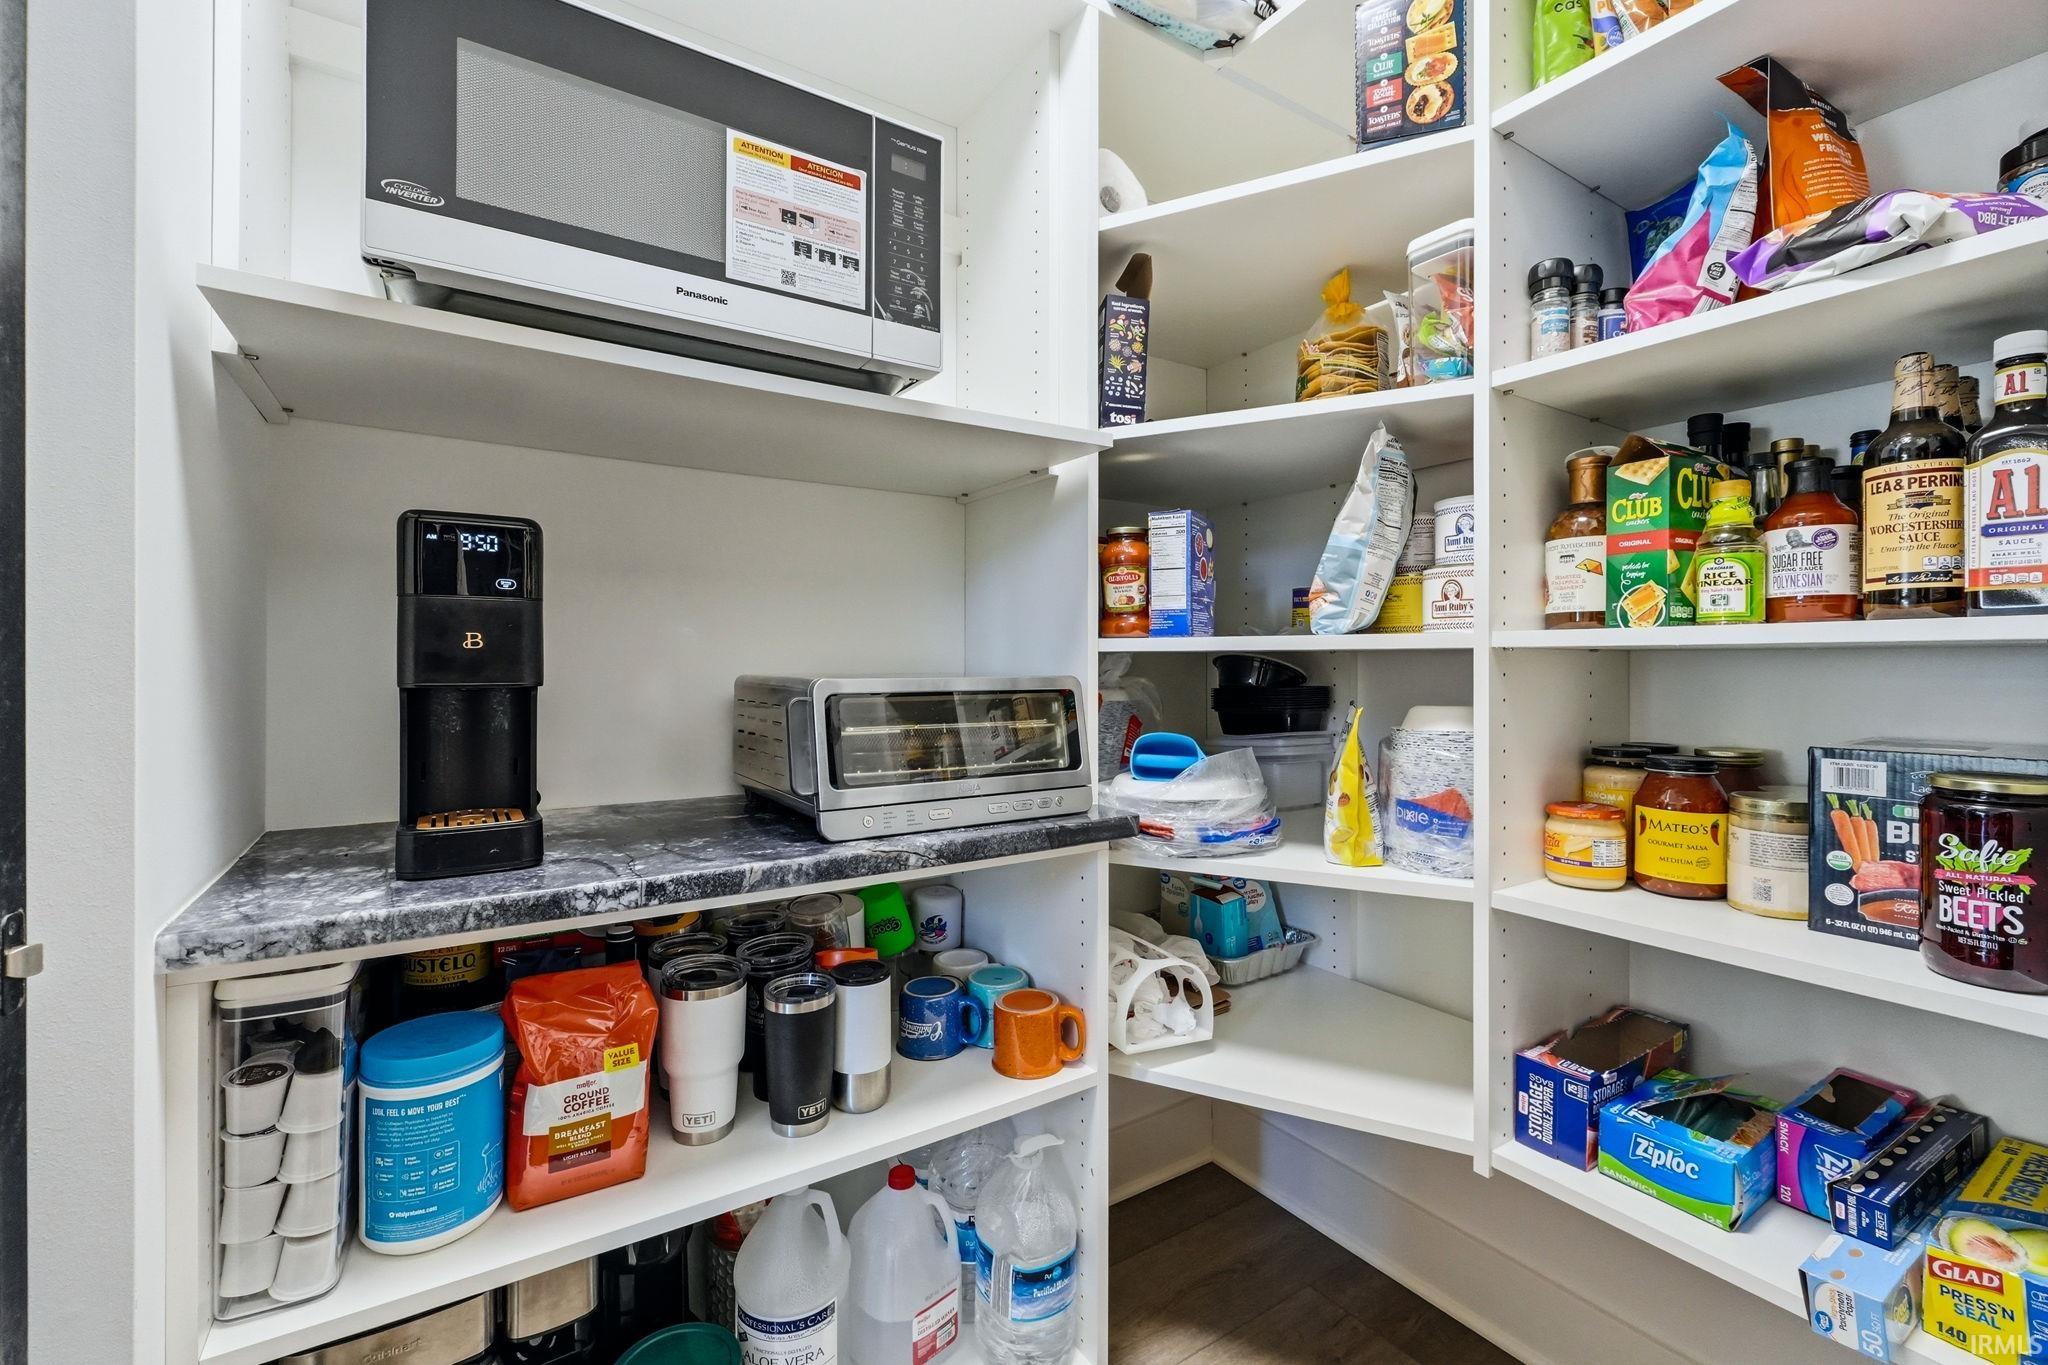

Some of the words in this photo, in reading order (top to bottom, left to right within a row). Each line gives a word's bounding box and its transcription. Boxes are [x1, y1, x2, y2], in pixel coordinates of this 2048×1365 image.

[741, 141, 784, 160] ATTENTION
[385, 186, 438, 204] INVERTER
[1977, 211, 1998, 225] BBQ
[676, 286, 728, 305] Panasonic
[1906, 461, 1955, 470] NATURAL
[1871, 480, 1892, 495] LEA
[1893, 478, 1905, 491] &
[1611, 496, 1663, 523] CLUB
[1888, 512, 1908, 521] The
[1908, 509, 1951, 520] Original
[1869, 519, 1964, 536] WORCESTERSHIR
[1988, 524, 2045, 534] ORIGINAL
[460, 533, 498, 553] 9:50
[1619, 540, 1652, 548] ORIGINAL
[1898, 531, 1941, 544] SAUCE
[1998, 538, 2035, 546] SAUCE
[1772, 552, 1798, 569] SUGAR
[1801, 551, 1824, 566] FREE
[1697, 578, 1754, 588] VINEGAR
[1703, 571, 1738, 580] RICE
[1772, 572, 1823, 589] POLYNESIAN
[1448, 601, 1474, 612] Ruby's
[463, 632, 484, 648] B
[1585, 791, 1625, 802] SONOMA
[1648, 818, 1709, 835] MATEO'S
[1647, 838, 1683, 849] GOURMET
[1659, 856, 1694, 866] MEDIUM
[1938, 833, 2020, 872] Safie
[1965, 873, 2015, 883] NATURAL
[1938, 880, 1971, 897] Sweet
[1976, 887, 2024, 904] Pickled
[1939, 894, 2025, 936] BEETS
[608, 1047, 636, 1060] VALUE
[612, 1057, 632, 1068] SIZE
[1528, 1072, 1554, 1089] BAGS
[563, 1086, 610, 1105] GROUND
[1592, 1079, 1624, 1104] STORAGE
[386, 1108, 399, 1117] FEEL
[407, 1105, 425, 1116] MOVE
[427, 1101, 443, 1113] YOUR
[563, 1094, 610, 1115] COFFEE
[800, 1099, 827, 1117] YETI
[1543, 1086, 1554, 1115] ZIPPER
[572, 1109, 595, 1118] ARABICA
[595, 1102, 615, 1112] COFFEE
[1528, 1080, 1543, 1140] STORAGE
[684, 1114, 714, 1125] YETI
[554, 1120, 607, 1140] BREAKFAST
[569, 1131, 592, 1142] BLEND
[1542, 1113, 1554, 1145] DOUBLE
[1779, 1121, 1789, 1154] SNACK
[562, 1153, 579, 1161] LIGHT
[580, 1148, 598, 1157] ROAST
[1634, 1136, 1700, 1180] Ziploc
[1602, 1166, 1657, 1197] SANDWICH
[1780, 1184, 1792, 1202] 120
[1846, 1193, 1857, 1207] FOIL
[1702, 1212, 1724, 1228] 125
[1847, 1205, 1858, 1237] ALUMINUM
[1931, 1260, 2000, 1288] GLAD
[1033, 1284, 1055, 1298] Purified
[1836, 1290, 1848, 1332] Parchment
[1940, 1283, 2015, 1322] PRESS'N
[807, 1306, 834, 1325] CARE
[1953, 1302, 2002, 1330] SEAL
[1936, 1321, 1967, 1343] 140
[1861, 1329, 1884, 1358] 50
[743, 1350, 779, 1365] ALOE
[784, 1347, 825, 1365] VERA
